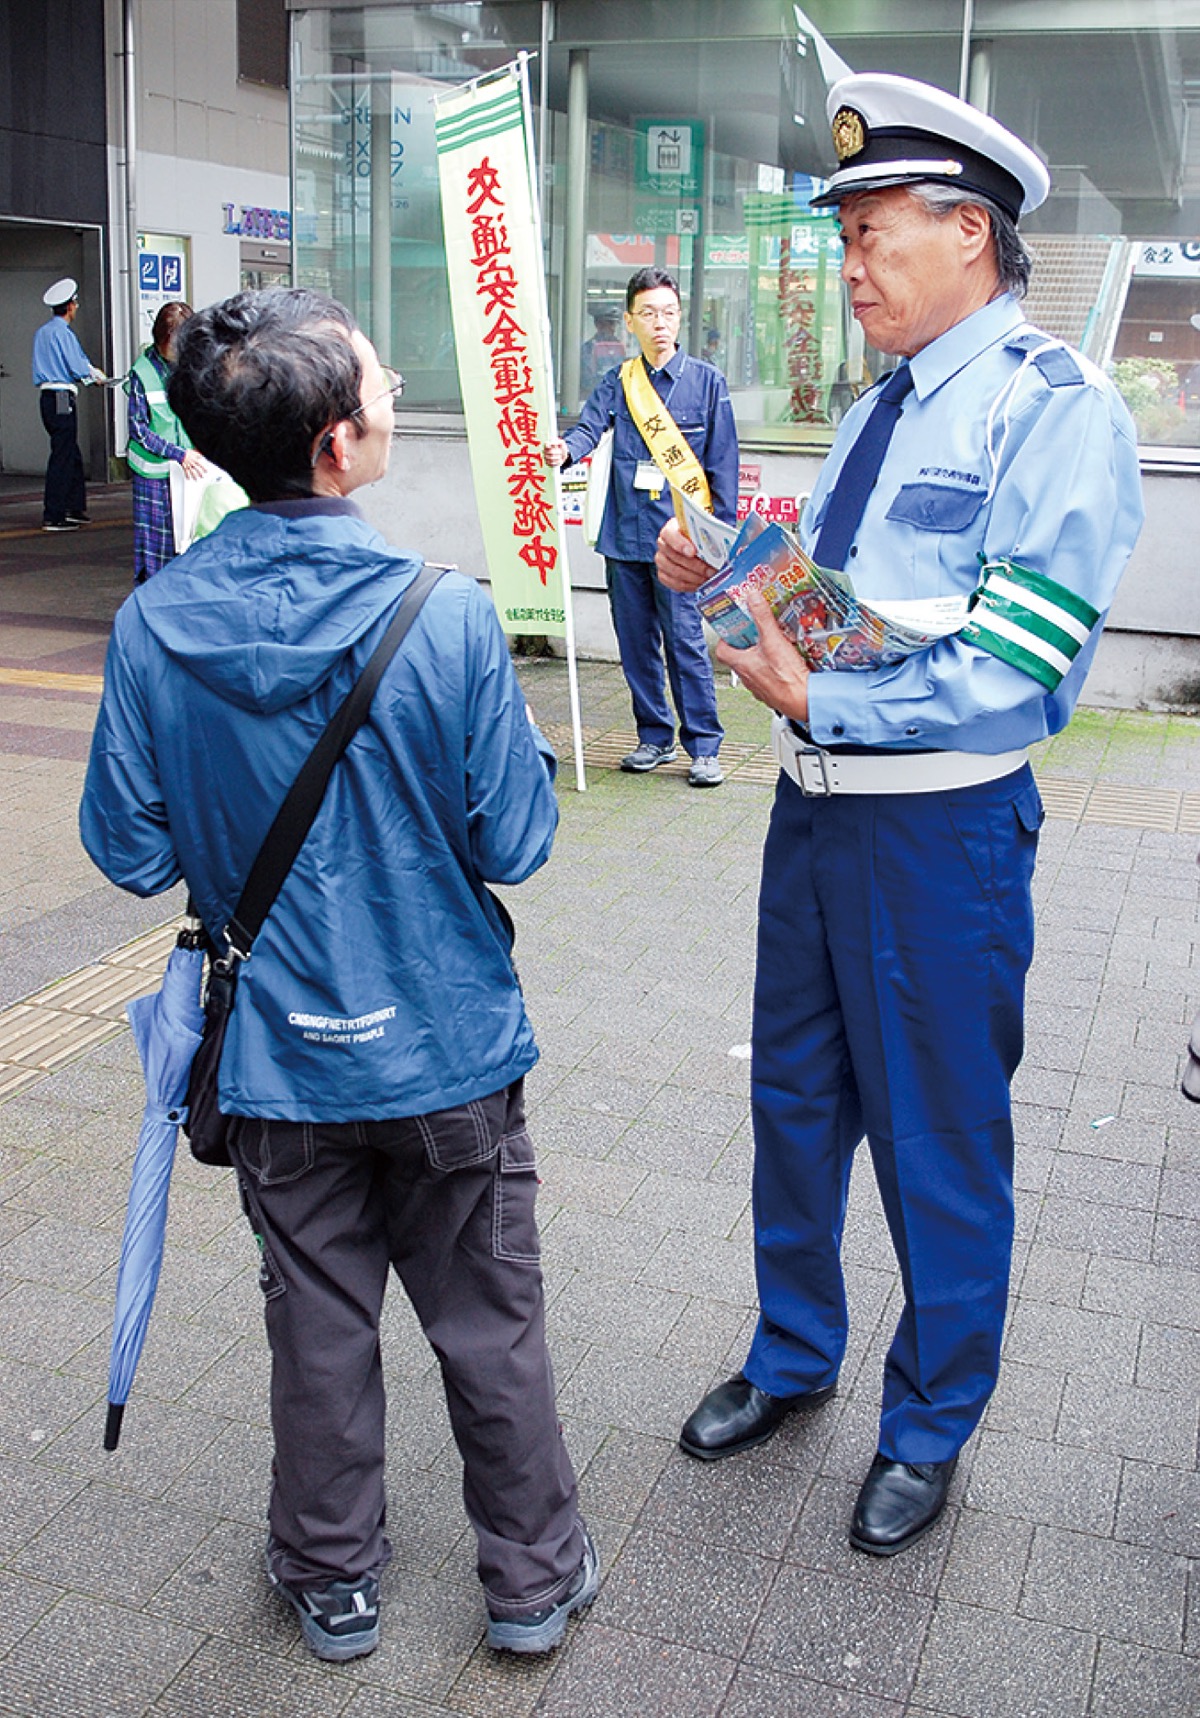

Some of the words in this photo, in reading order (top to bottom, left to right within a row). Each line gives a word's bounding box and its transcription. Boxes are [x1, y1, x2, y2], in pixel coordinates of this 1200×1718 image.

[342, 107, 411, 124] GREN
[346, 141, 404, 157] EXO
[346, 160, 404, 177] 207
[643, 413, 714, 512] 交通安
